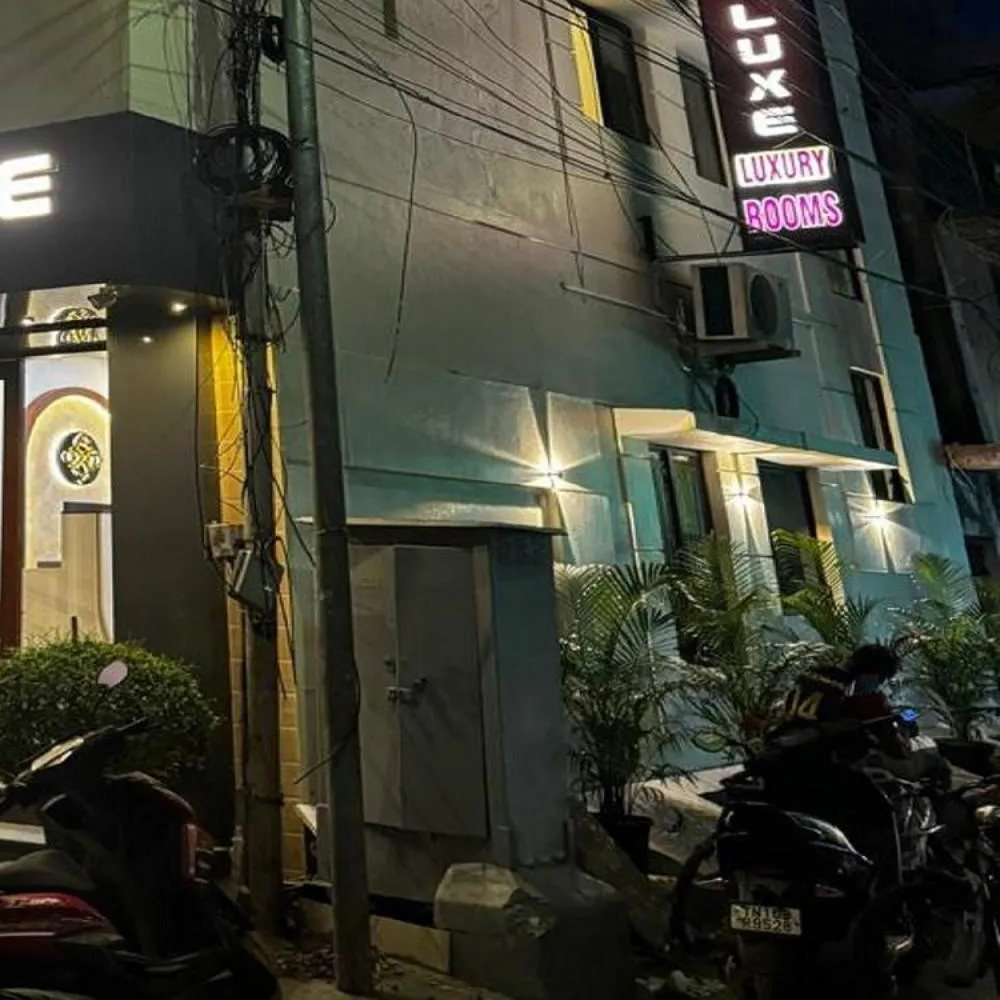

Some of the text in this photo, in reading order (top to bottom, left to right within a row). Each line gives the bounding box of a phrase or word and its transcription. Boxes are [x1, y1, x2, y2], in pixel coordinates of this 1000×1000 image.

[728, 3, 799, 137] LUXE
[739, 149, 825, 183] LUXURY
[743, 190, 843, 232] ROOMS
